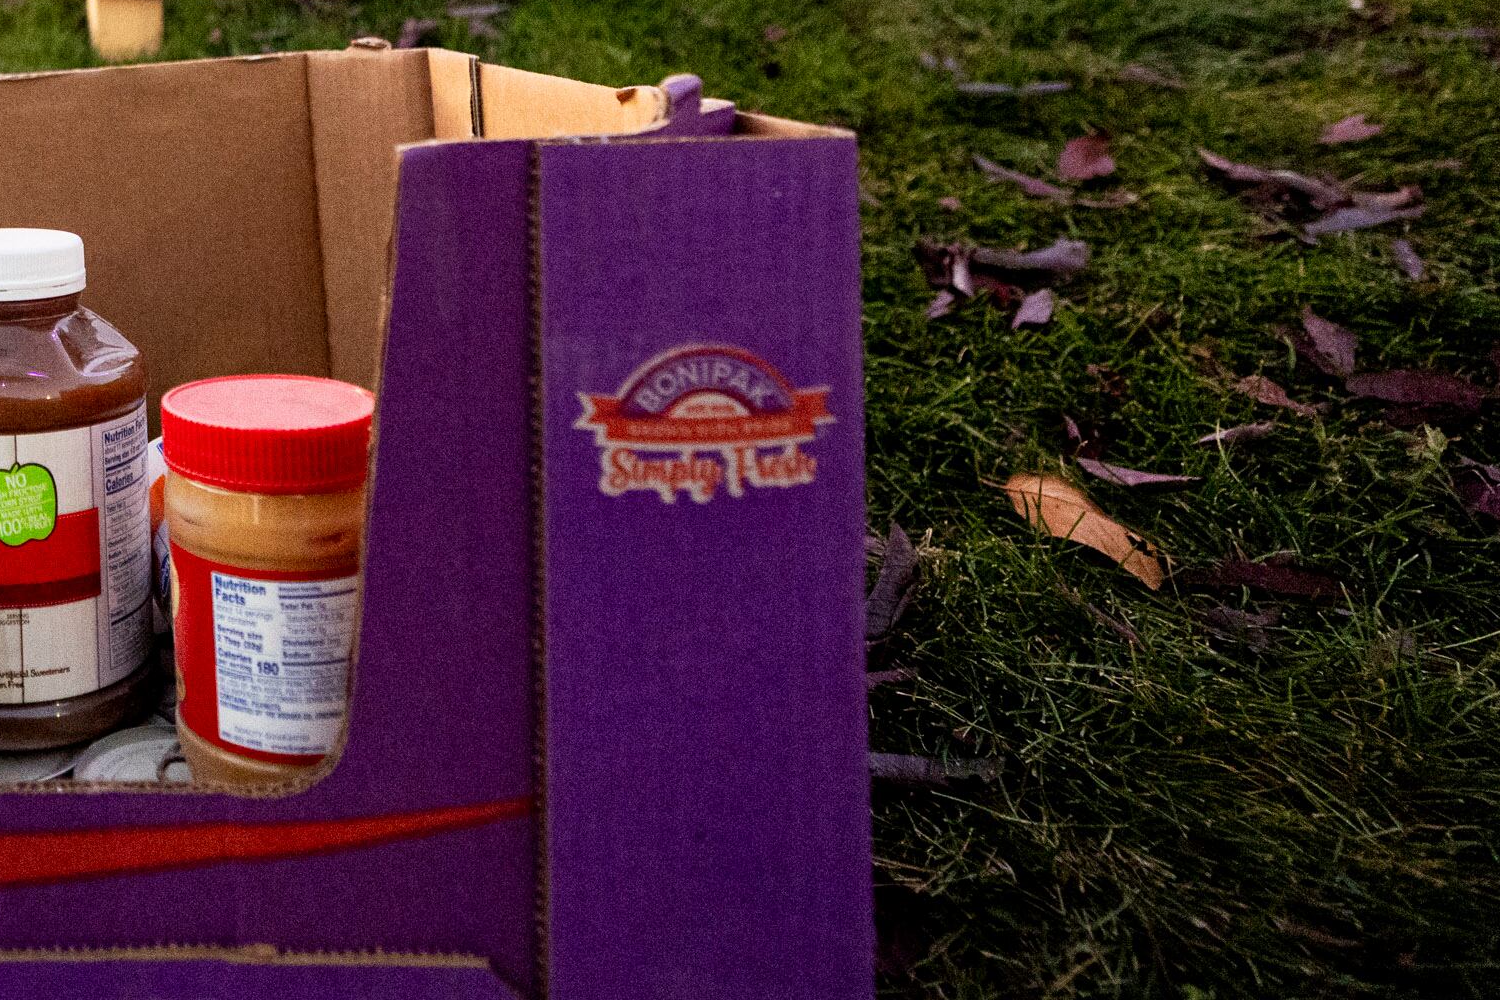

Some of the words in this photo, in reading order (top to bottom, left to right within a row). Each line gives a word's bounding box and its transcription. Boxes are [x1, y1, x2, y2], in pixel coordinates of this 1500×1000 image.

[634, 359, 771, 413] BONIPAK
[104, 426, 134, 444] Nutrition
[5, 473, 27, 488] NO
[215, 576, 266, 595] Nutrition
[215, 588, 245, 605] Facts
